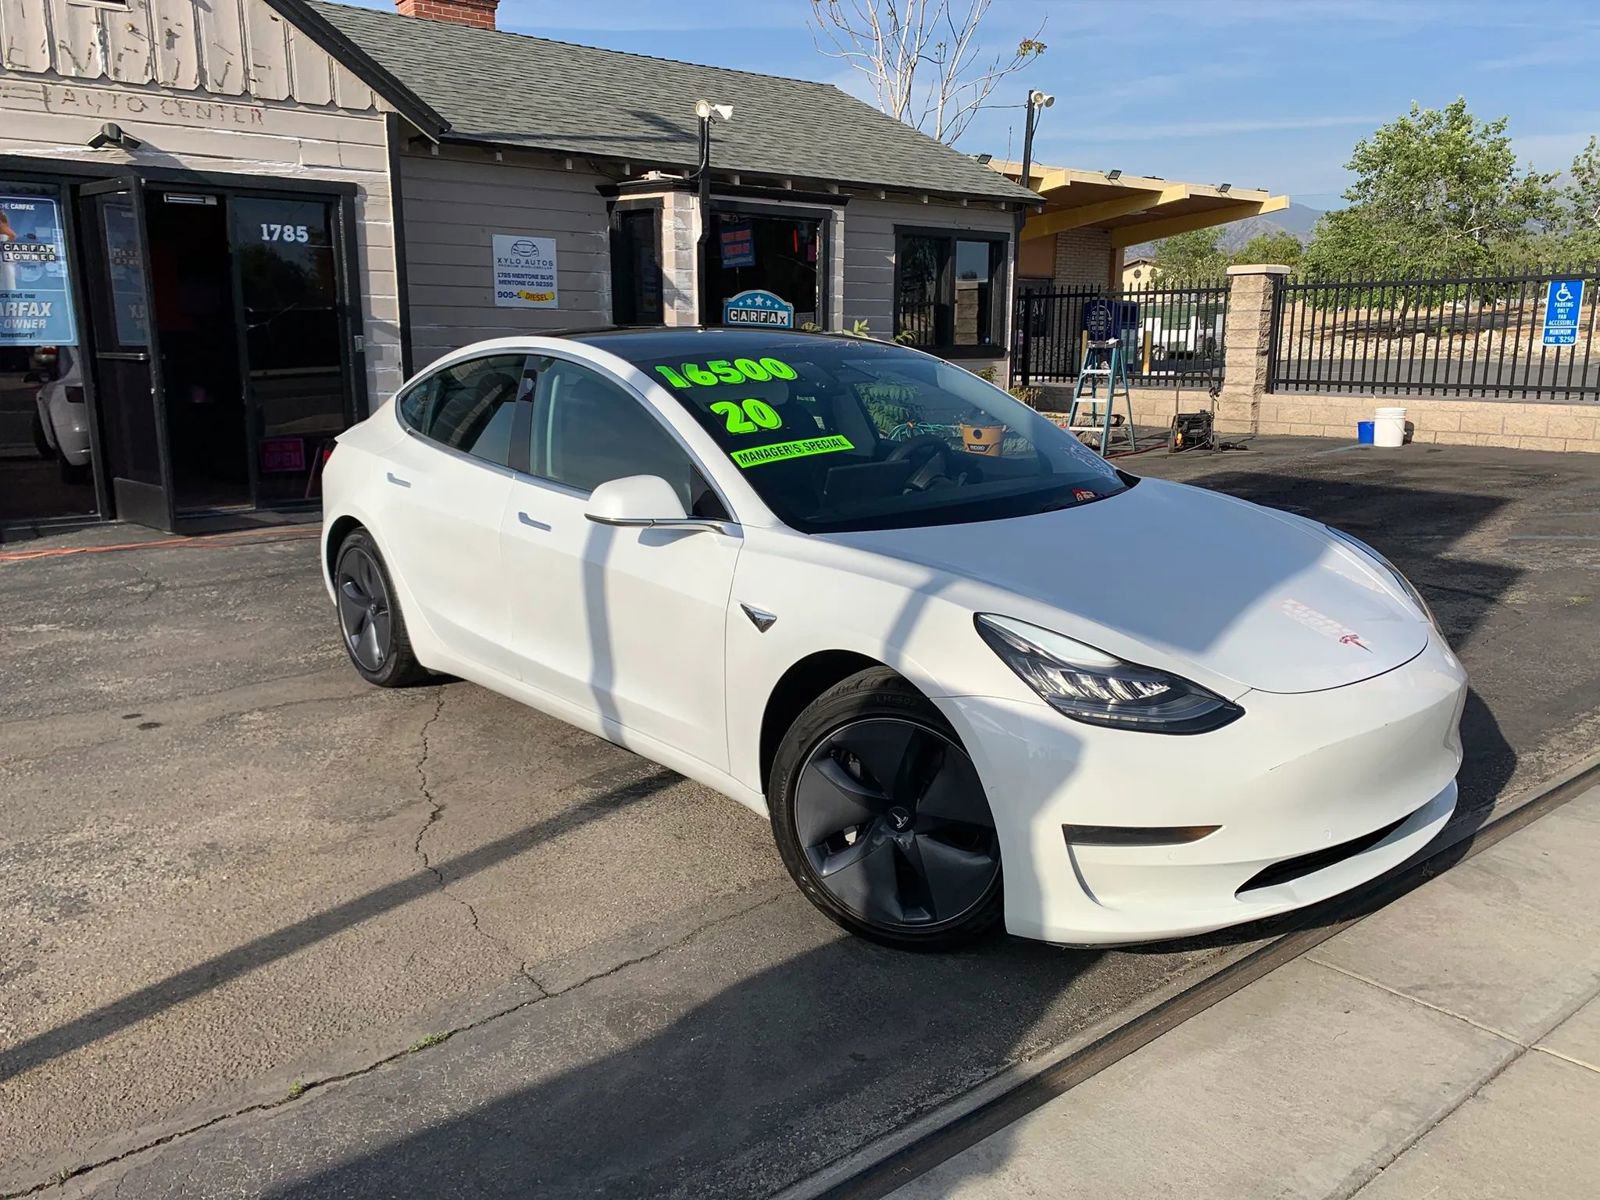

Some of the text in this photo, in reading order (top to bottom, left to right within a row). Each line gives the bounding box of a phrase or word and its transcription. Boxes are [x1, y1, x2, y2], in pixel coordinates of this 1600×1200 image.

[261, 223, 309, 243] 1785
[4, 243, 56, 253] CARFAX
[731, 310, 786, 325] CARFAX
[655, 357, 798, 388] 16500
[710, 399, 783, 434] 20
[737, 437, 849, 464] MANAGER'S SPECIAL
